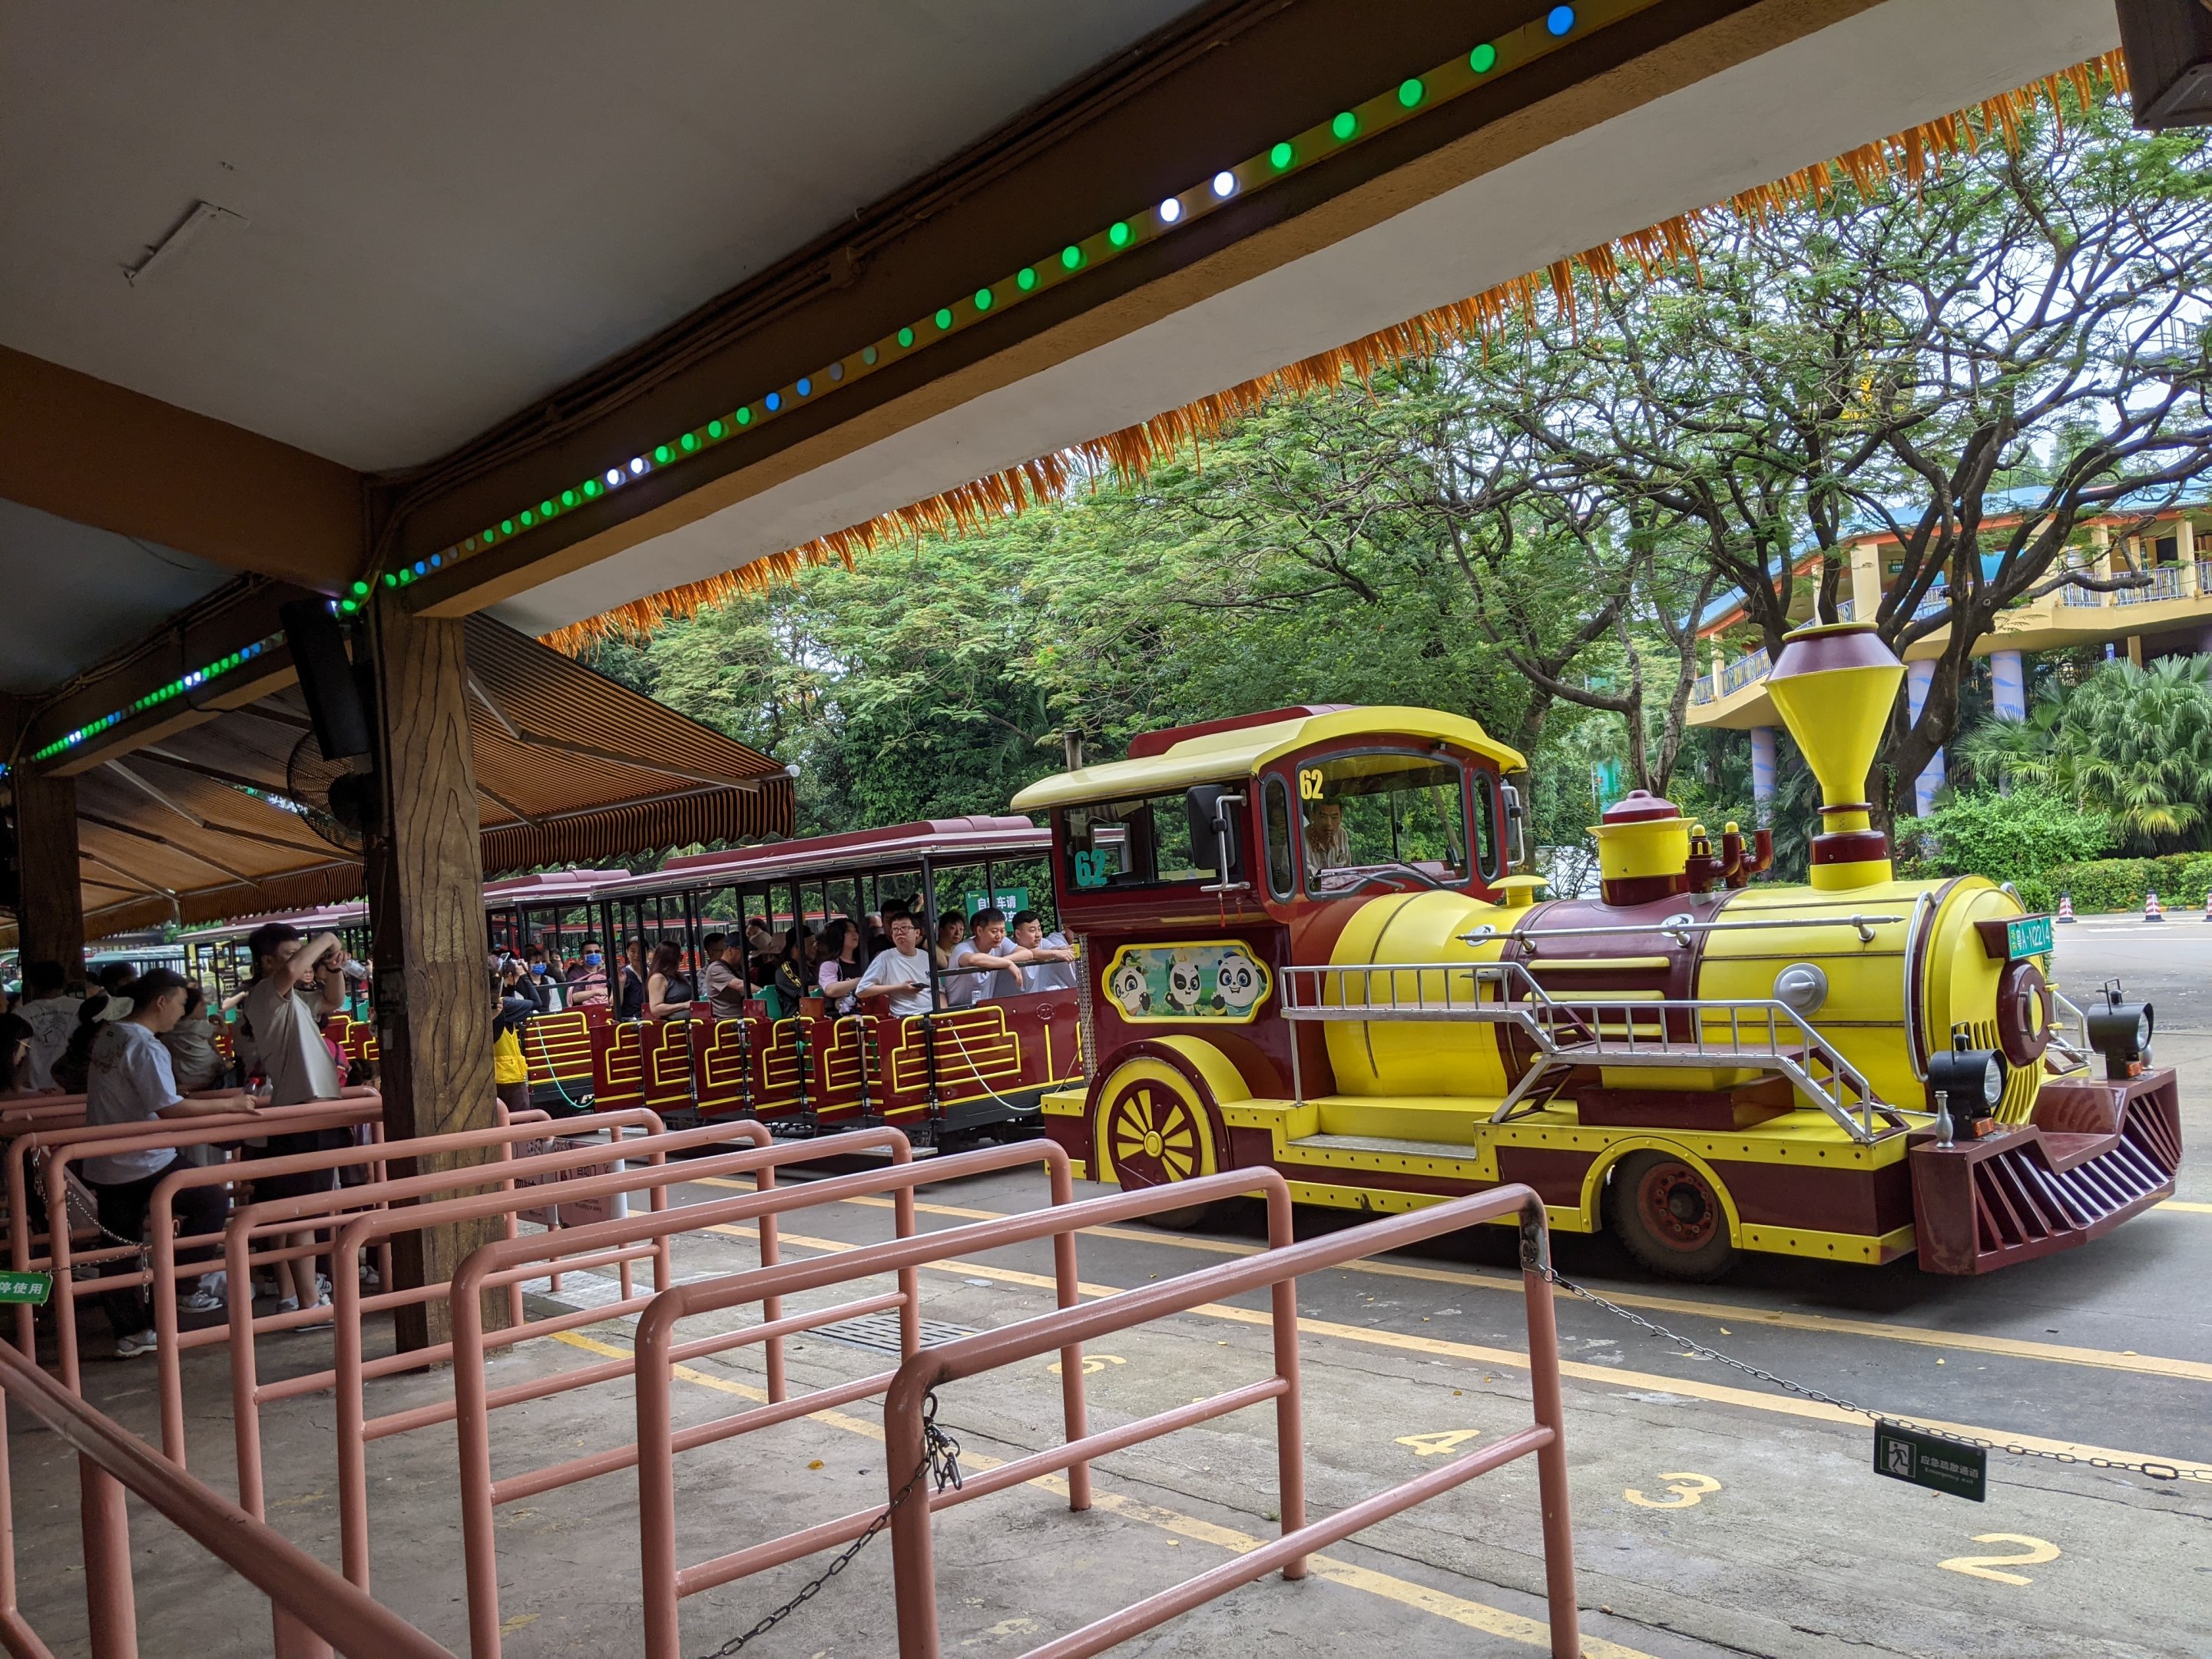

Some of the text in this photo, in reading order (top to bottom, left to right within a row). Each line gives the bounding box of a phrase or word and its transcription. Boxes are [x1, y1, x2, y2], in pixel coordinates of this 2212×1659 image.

[1299, 769, 1323, 800] 62
[1075, 848, 1108, 886] 62
[1393, 1429, 1482, 1456] 4
[1921, 1455, 1979, 1479] 应急疏散通道
[1623, 1472, 1721, 1509] 3
[1936, 1532, 2062, 1587] 2
